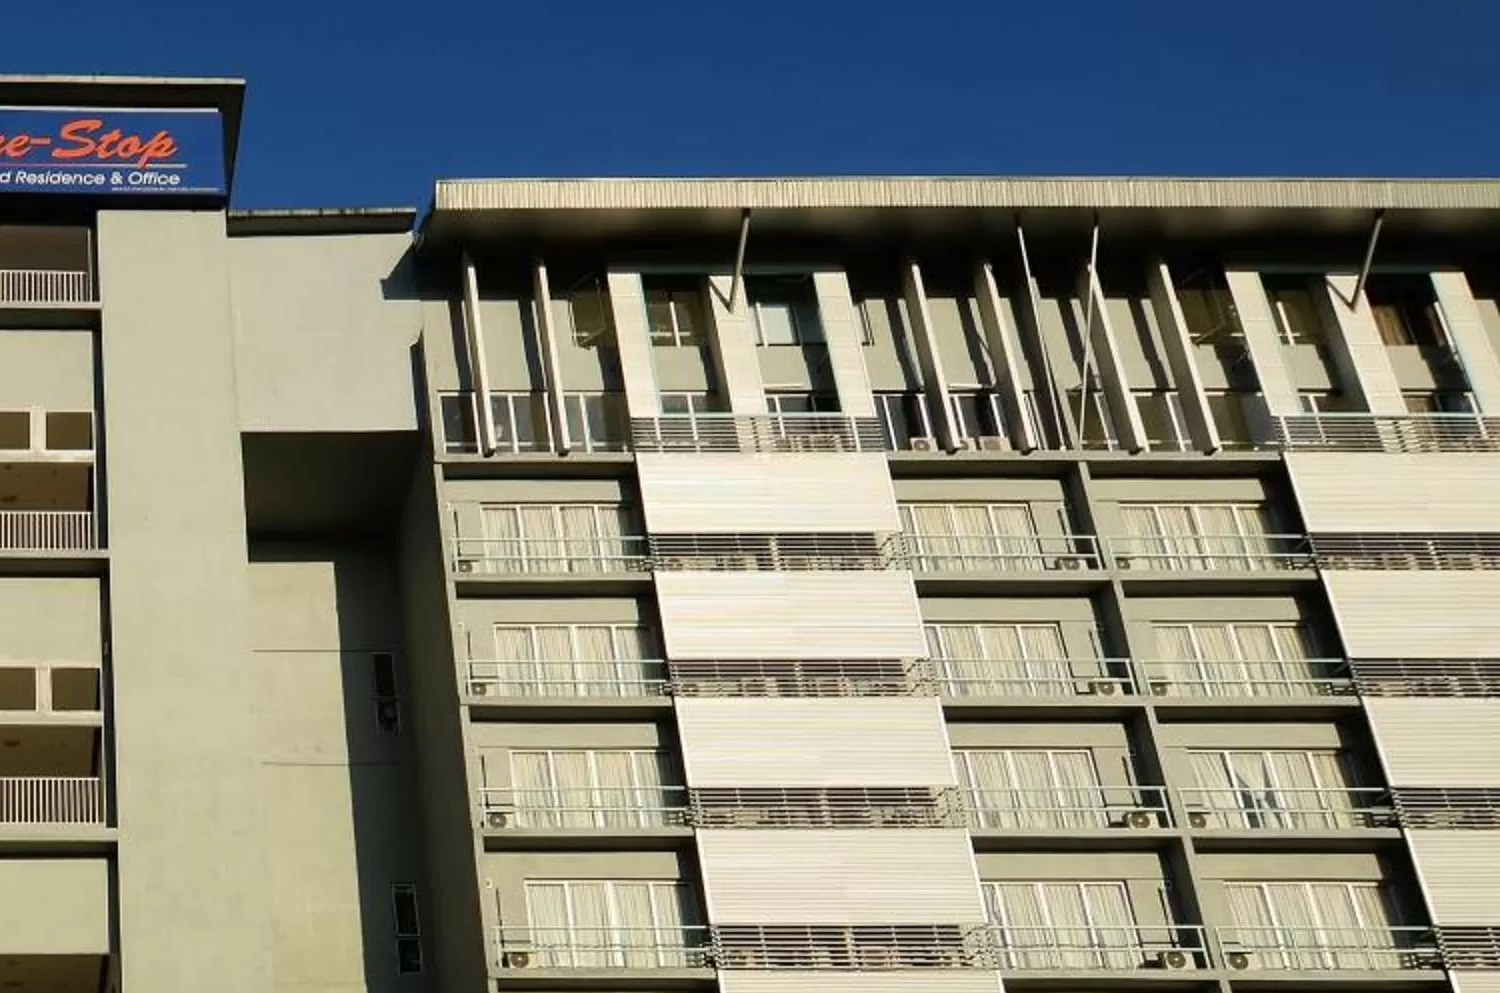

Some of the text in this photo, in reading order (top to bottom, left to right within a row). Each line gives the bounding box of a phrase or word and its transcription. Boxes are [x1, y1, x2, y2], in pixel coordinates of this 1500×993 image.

[14, 170, 105, 186] Residence
[109, 171, 123, 185] &
[127, 171, 180, 185] Office
